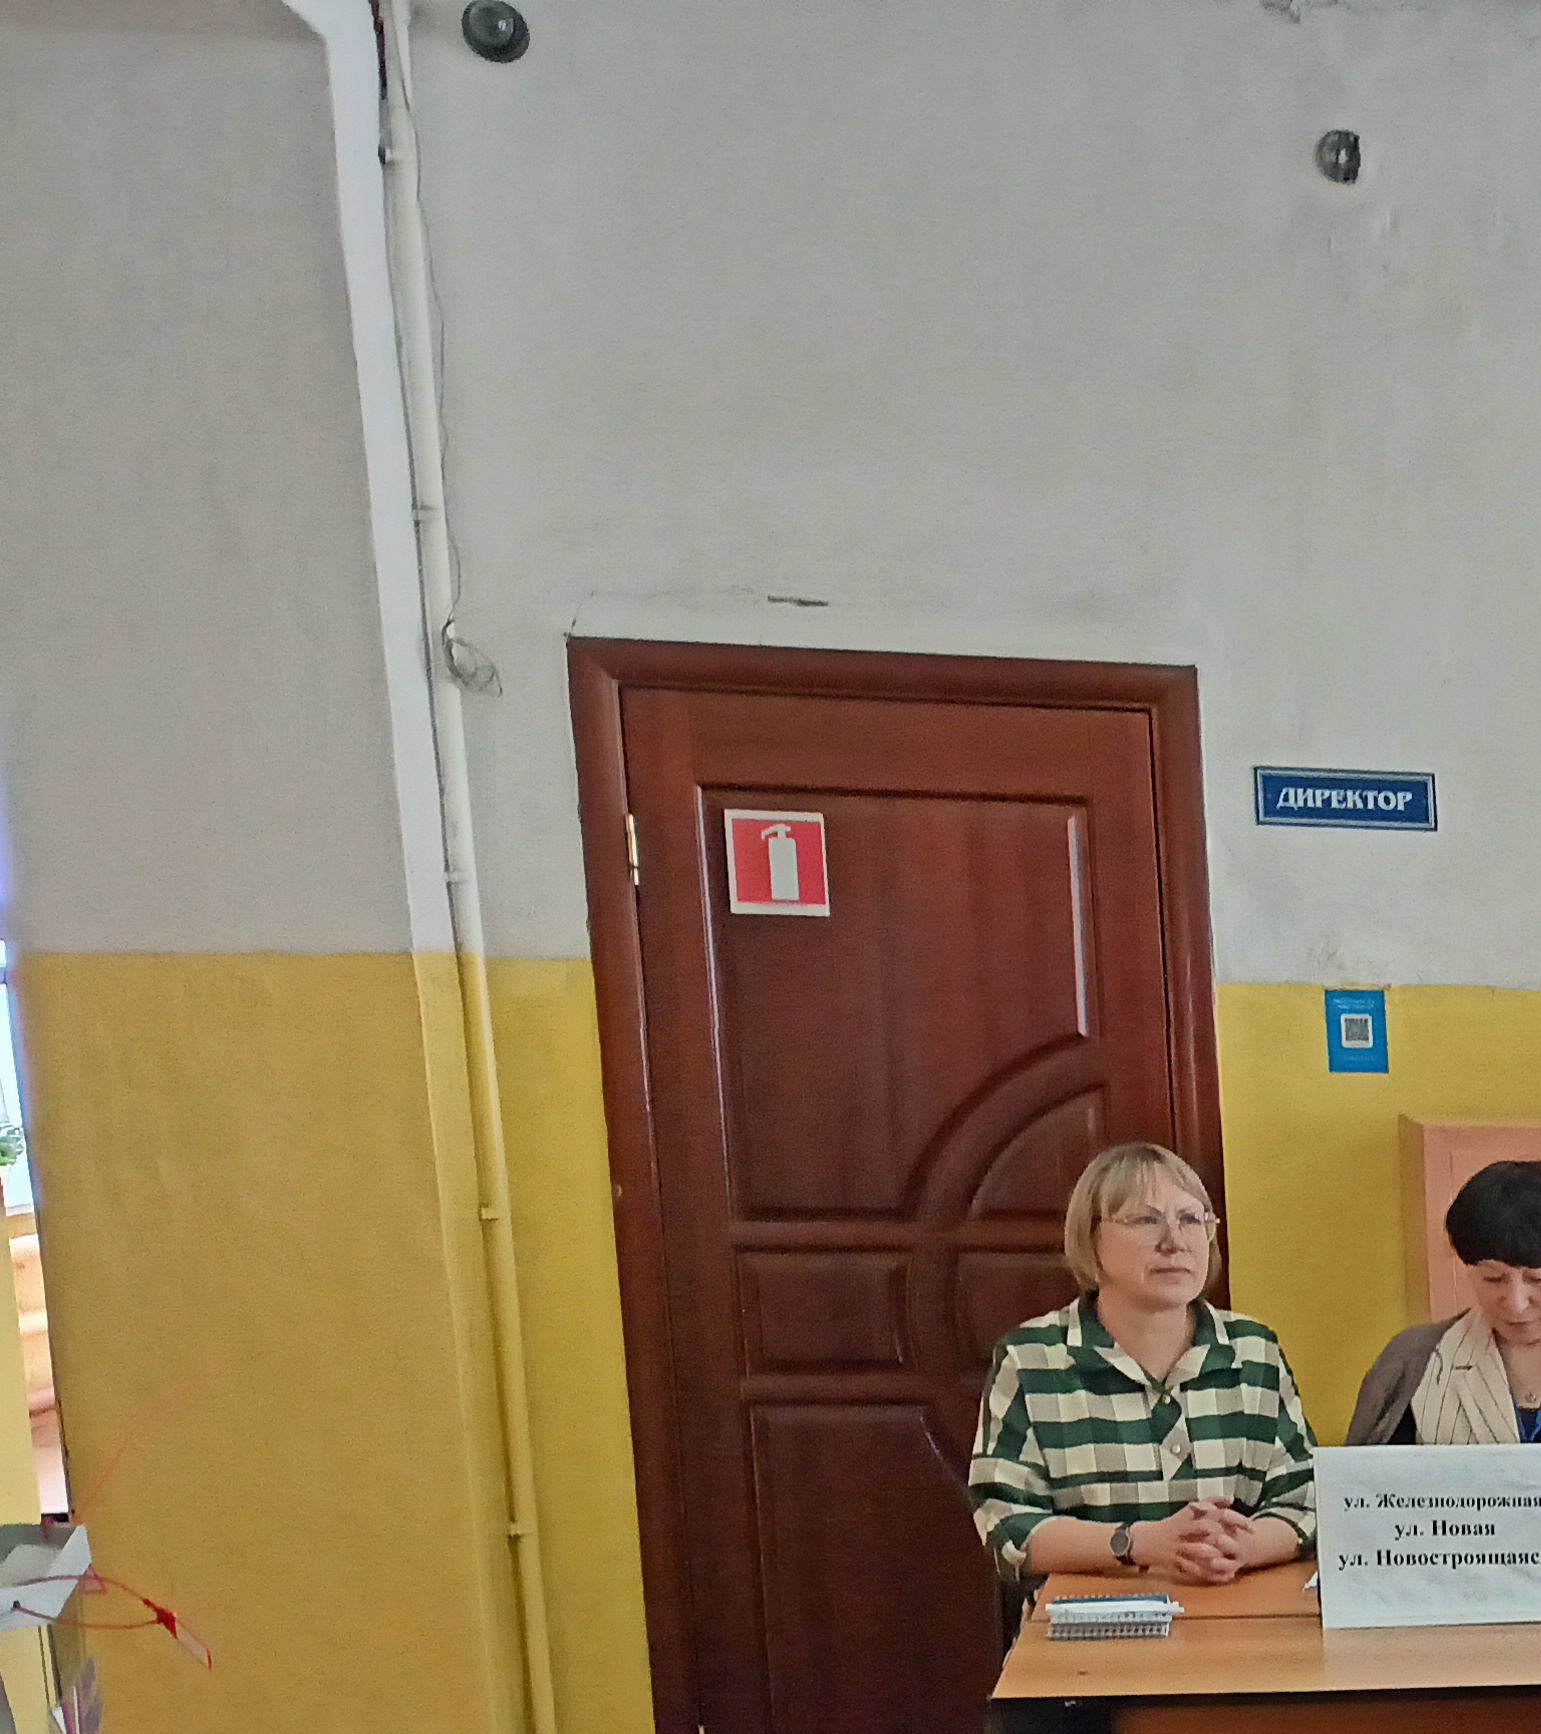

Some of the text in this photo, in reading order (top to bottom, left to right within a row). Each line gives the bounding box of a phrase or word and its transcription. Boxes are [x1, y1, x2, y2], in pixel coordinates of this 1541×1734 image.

[1276, 786, 1413, 812] ДИРЕКТОР
[1343, 1496, 1370, 1511] ул.
[1394, 1520, 1496, 1541] ул. Новая
[1338, 1552, 1369, 1569] ул.
